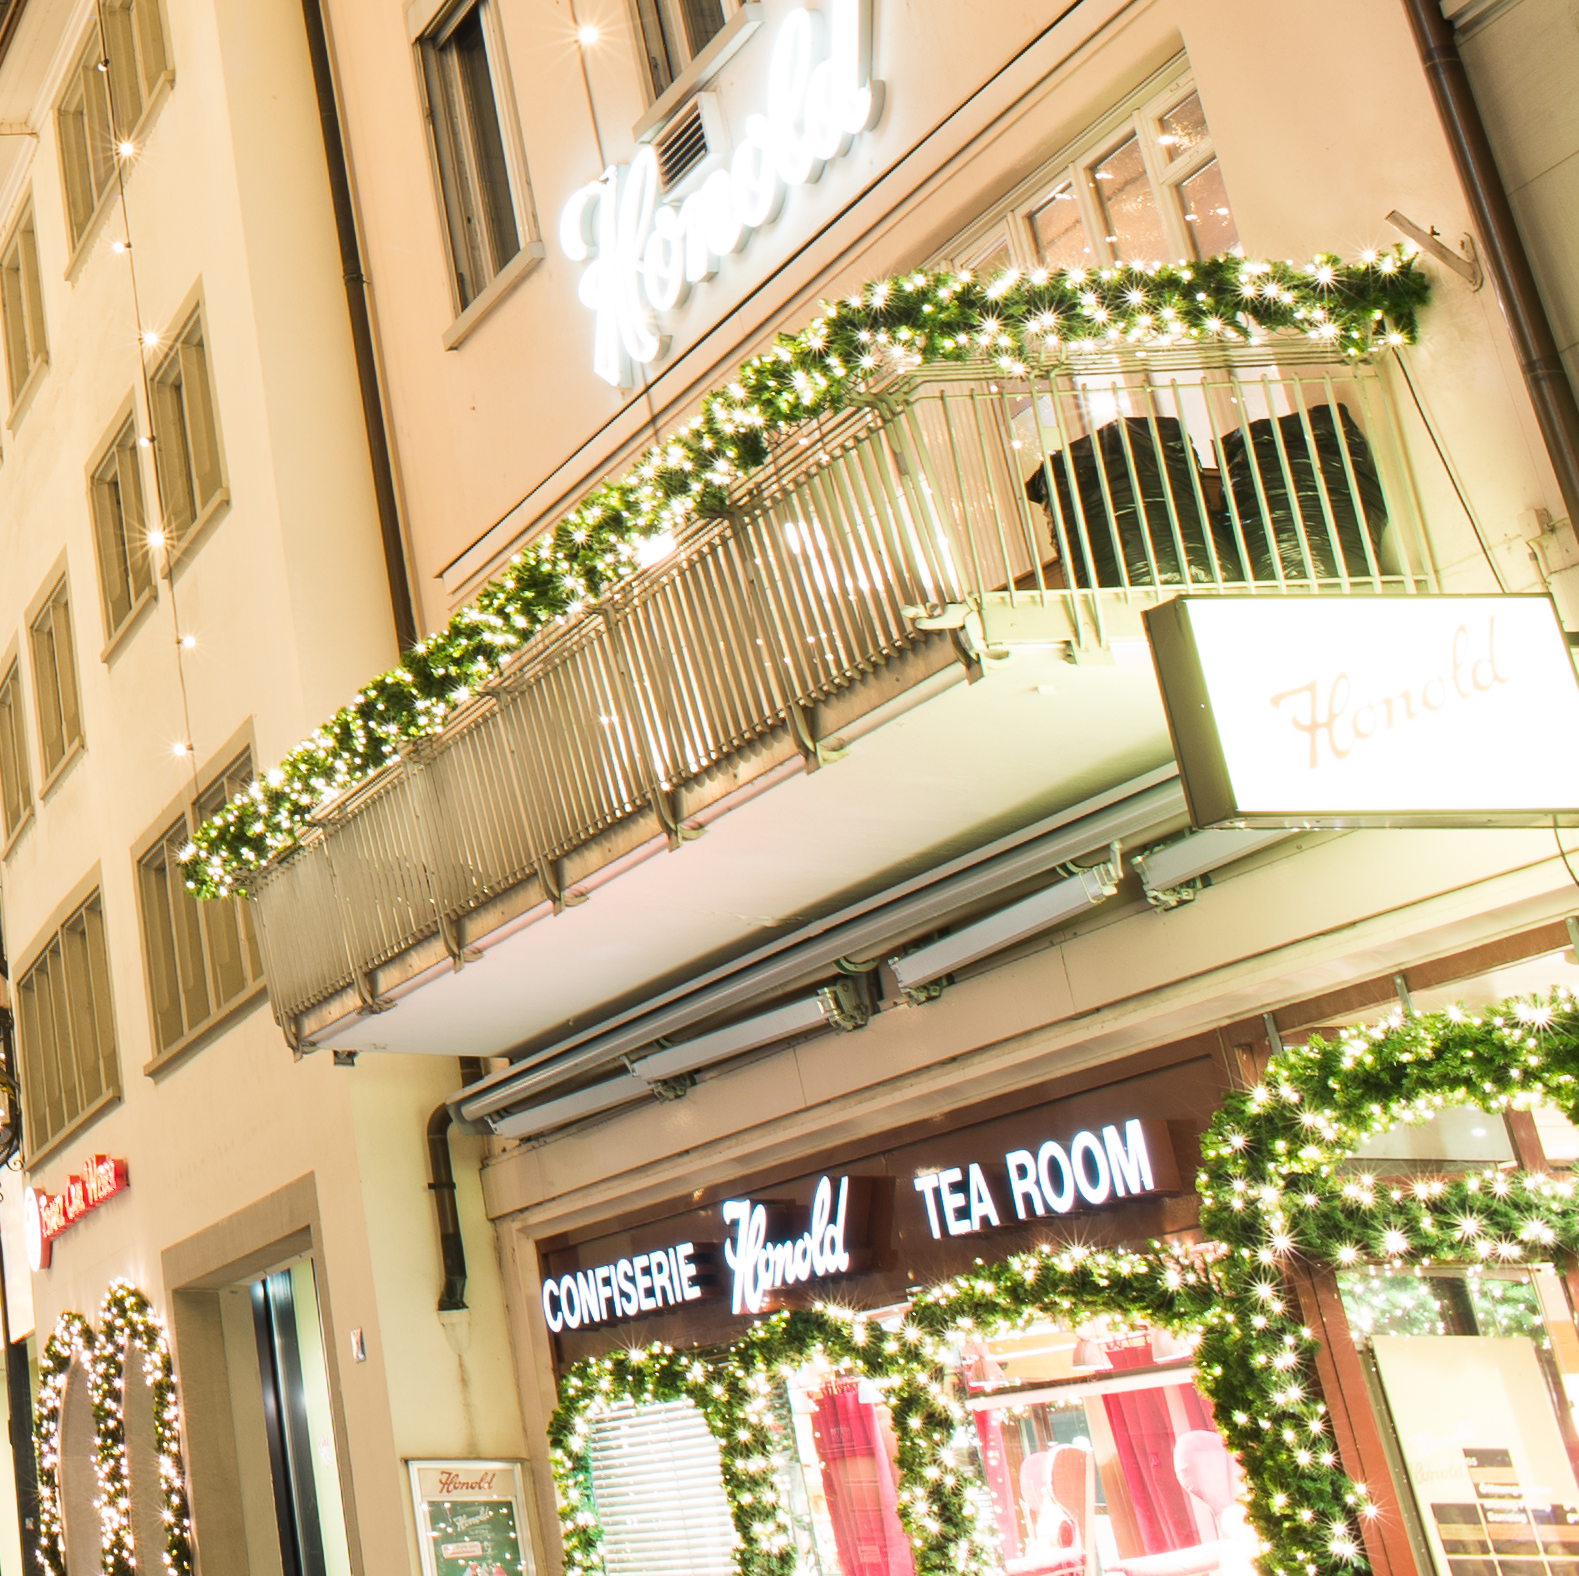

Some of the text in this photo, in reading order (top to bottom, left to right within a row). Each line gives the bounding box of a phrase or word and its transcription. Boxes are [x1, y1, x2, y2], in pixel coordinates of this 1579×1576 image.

[1270, 615, 1509, 770] Honold
[542, 1118, 1155, 1334] CONFISERIE Honold TEA ROOM
[439, 1471, 496, 1494] Honold
